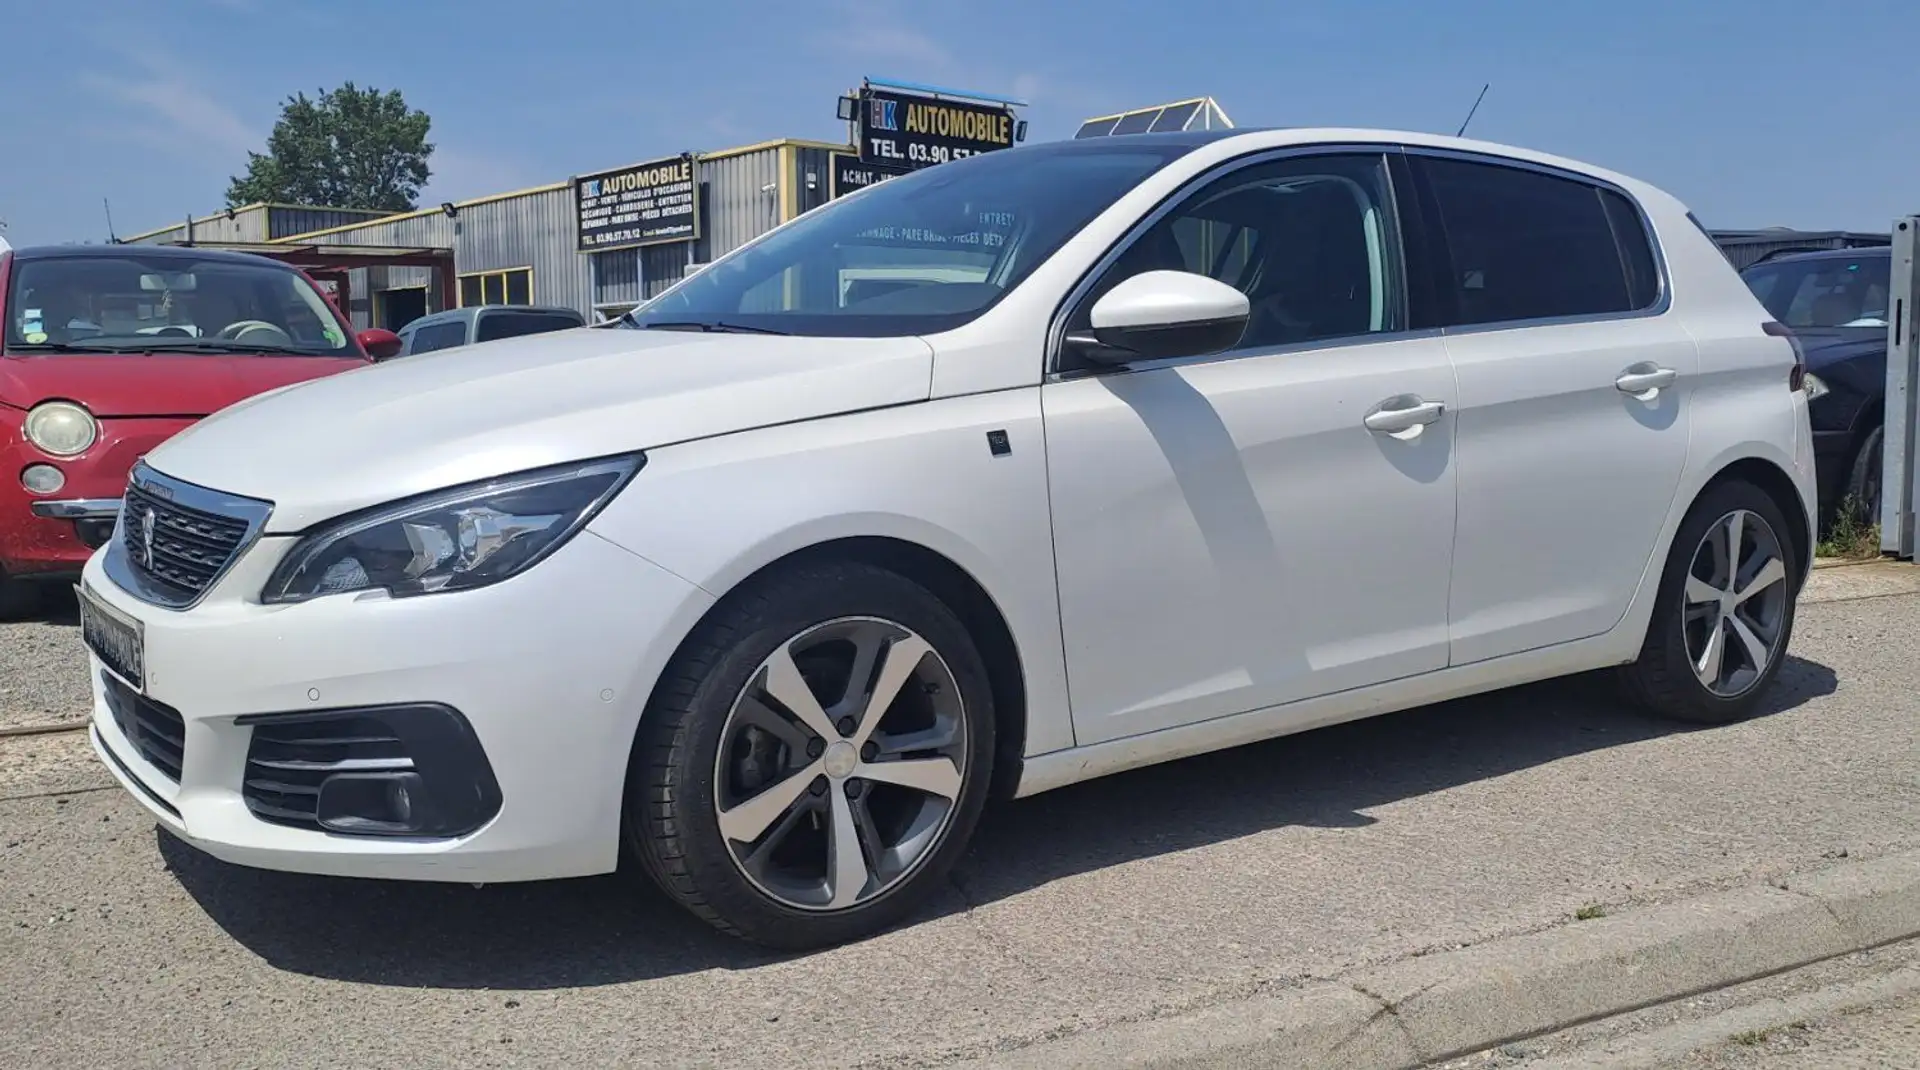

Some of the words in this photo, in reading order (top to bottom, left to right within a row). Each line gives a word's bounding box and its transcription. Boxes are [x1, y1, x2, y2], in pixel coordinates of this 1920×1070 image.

[870, 98, 898, 131] HK
[905, 103, 1009, 144] AUTOMOBILE
[871, 138, 905, 159] TEL.
[581, 180, 600, 199] HK
[602, 162, 690, 195] AUTOMOBILE
[842, 169, 873, 185] ACHAT
